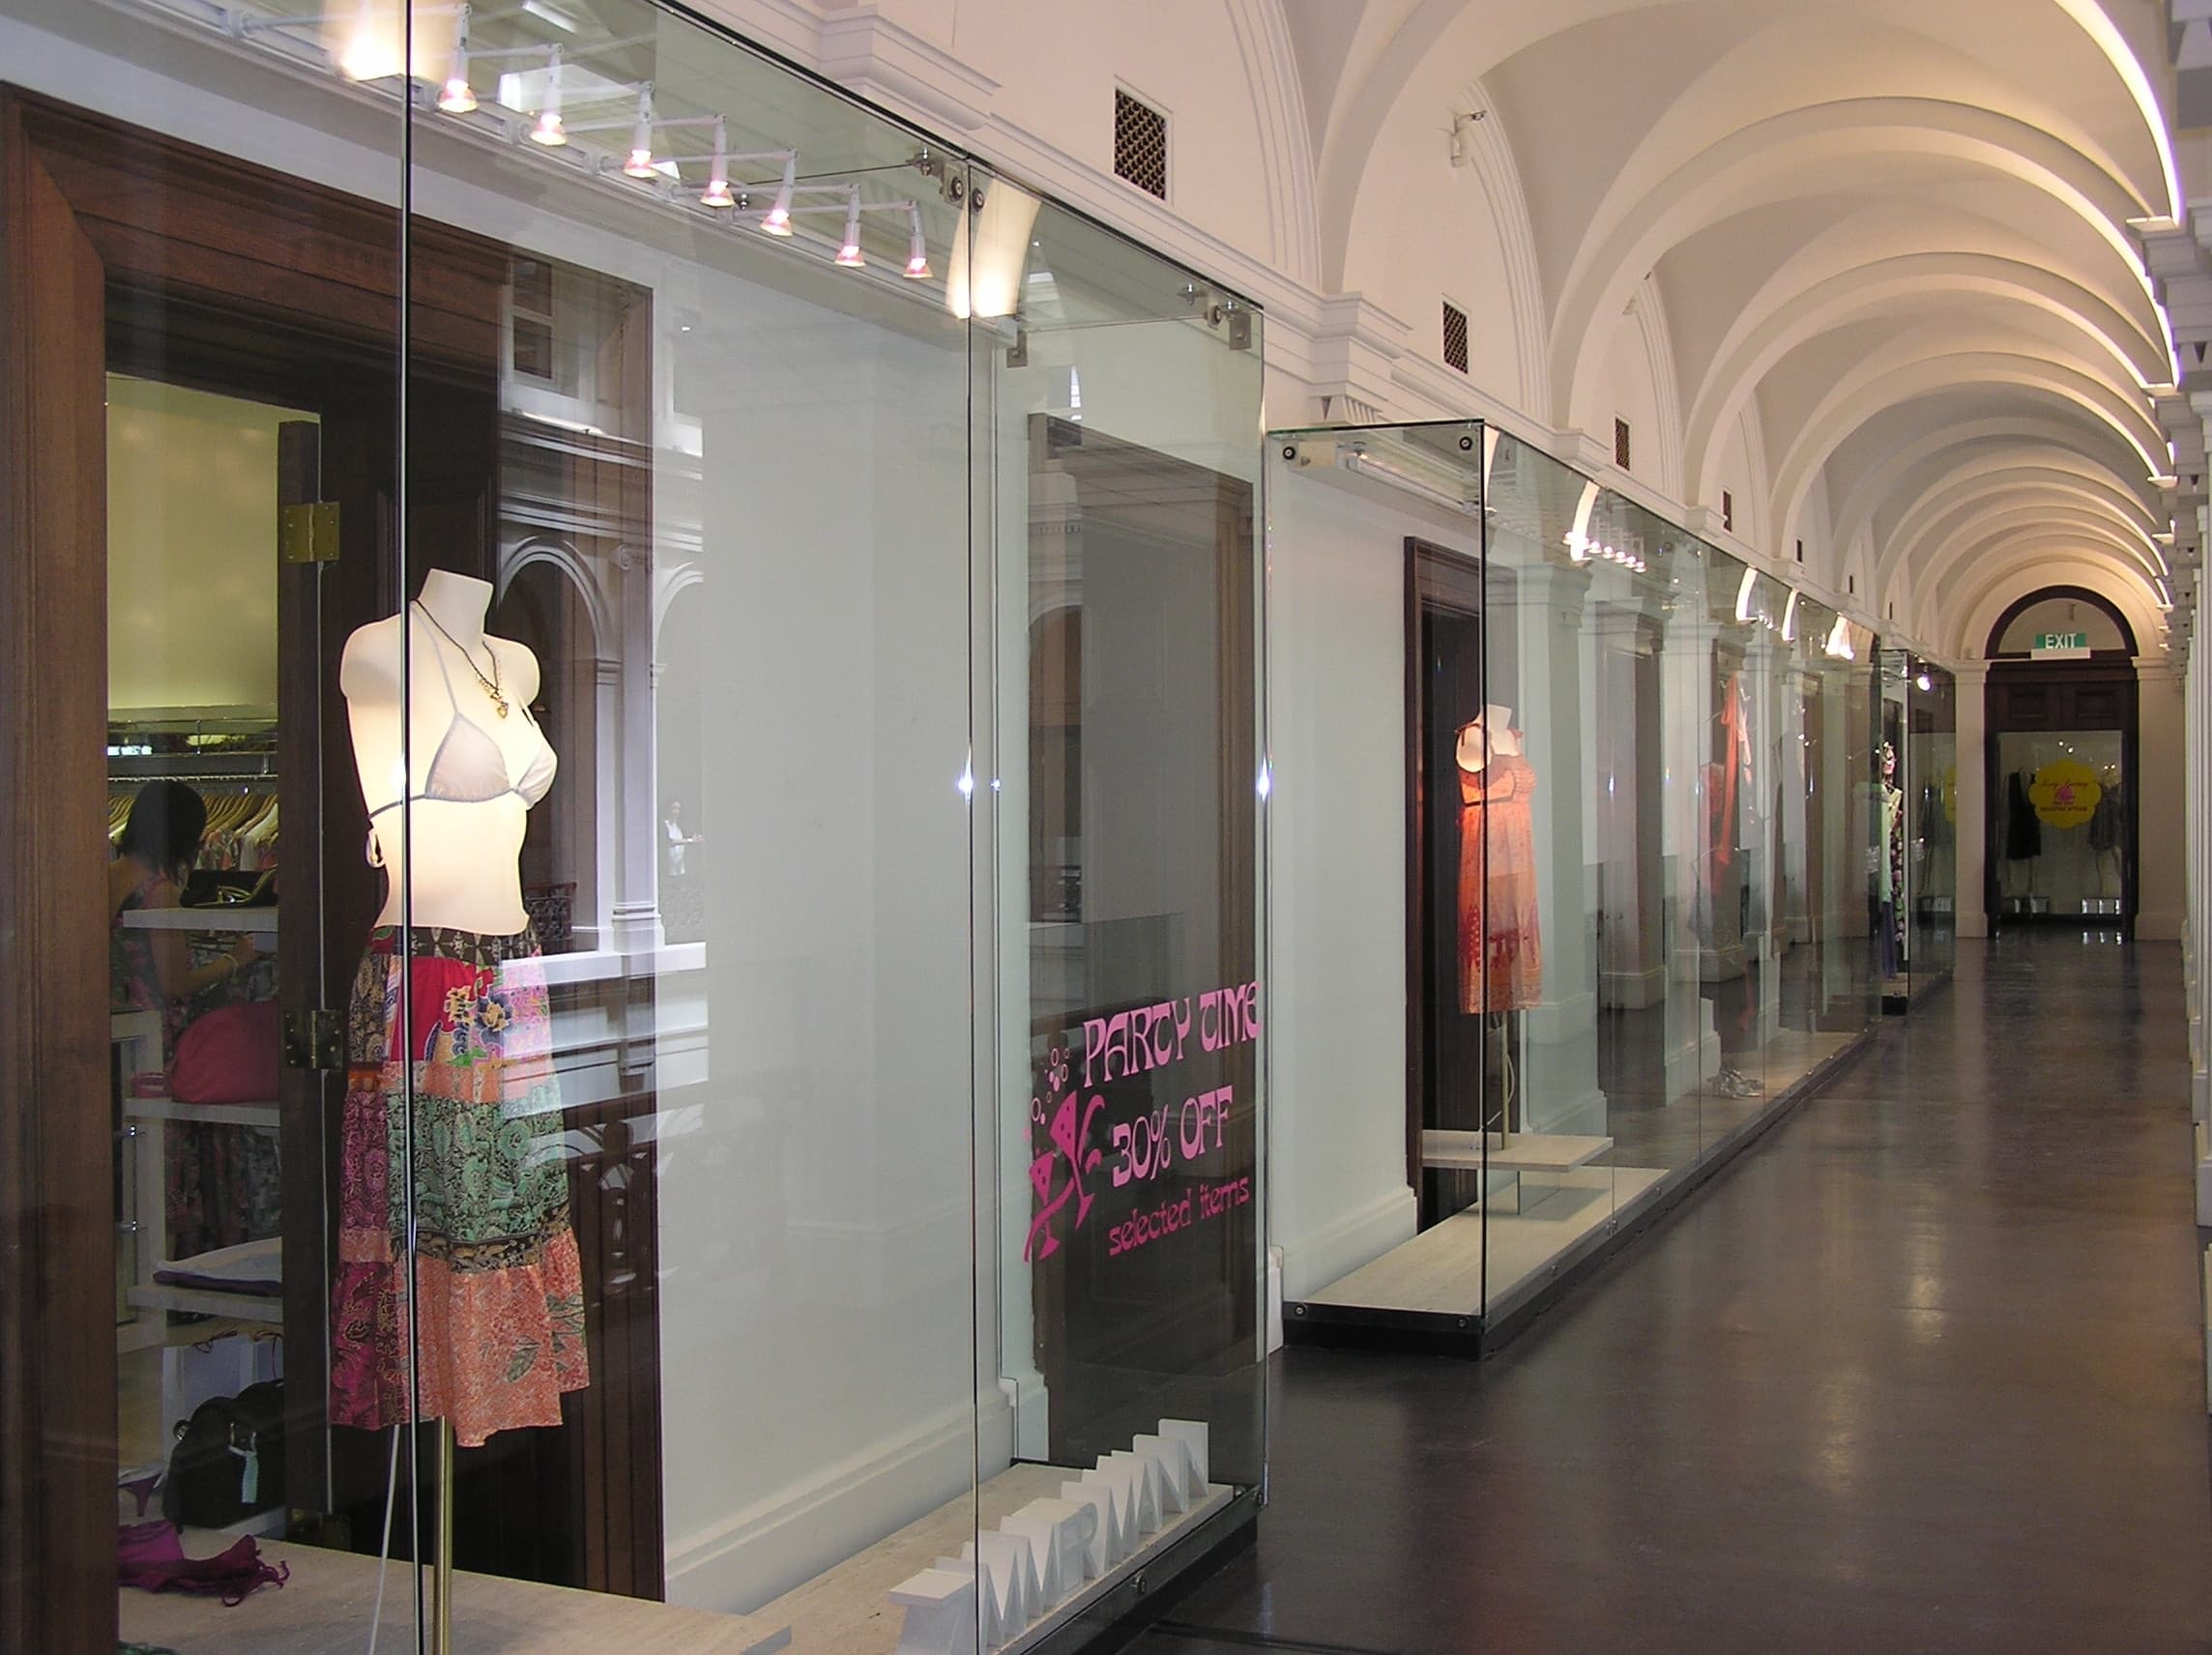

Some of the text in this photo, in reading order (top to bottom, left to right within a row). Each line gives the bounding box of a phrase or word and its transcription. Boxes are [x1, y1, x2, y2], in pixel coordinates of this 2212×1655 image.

[2045, 633, 2077, 649] EXIT
[1083, 980, 1263, 1088] PARTY TIME
[1113, 1085, 1234, 1187] 30% OFF
[1109, 1176, 1250, 1256] selected items
